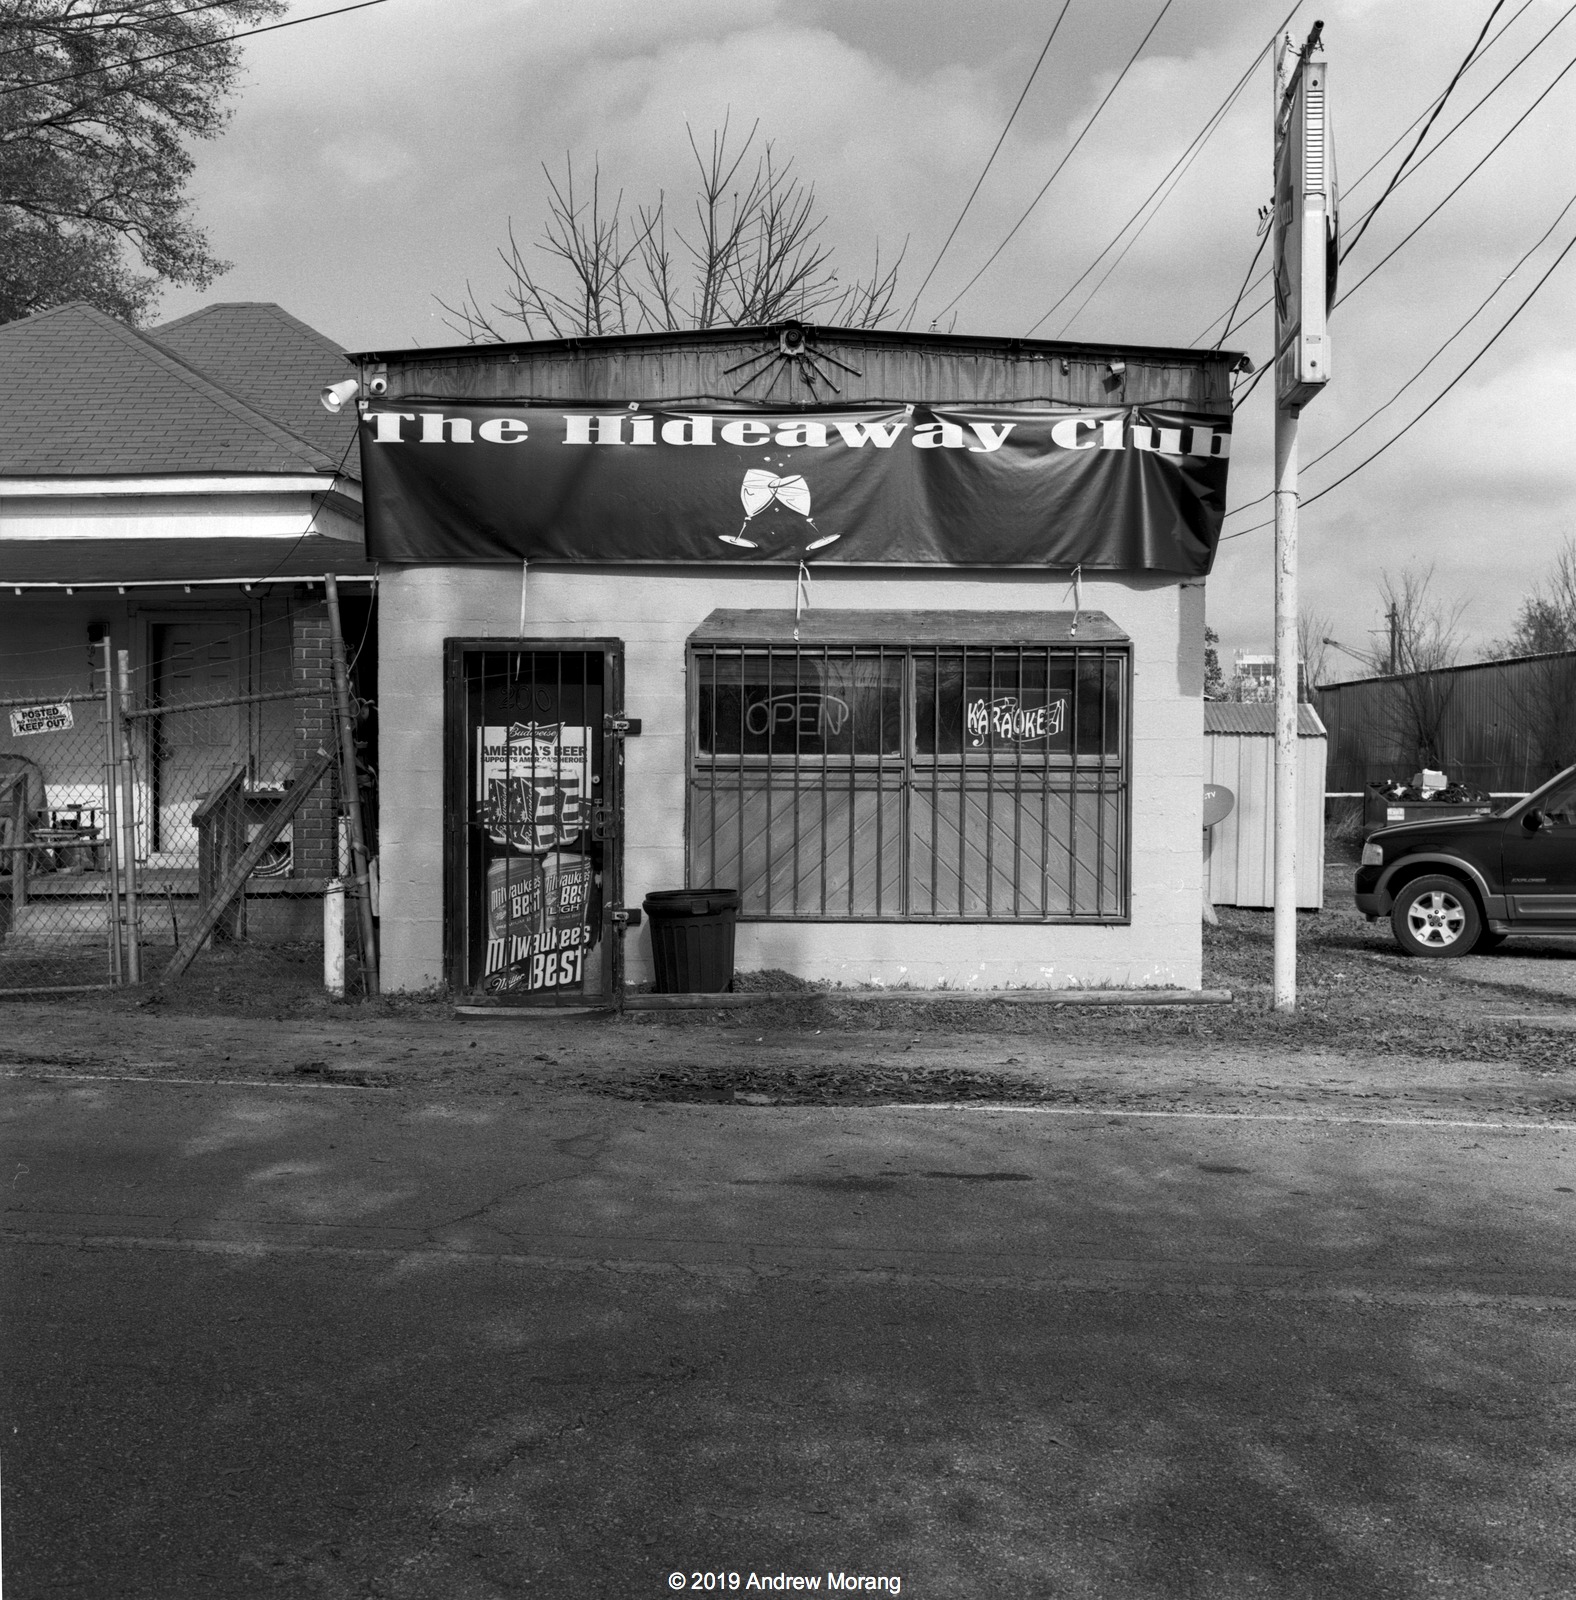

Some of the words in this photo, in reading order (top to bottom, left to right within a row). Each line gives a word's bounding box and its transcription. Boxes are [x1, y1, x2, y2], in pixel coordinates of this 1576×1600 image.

[362, 413, 528, 444] The
[562, 414, 1017, 453] Hideaway
[1051, 418, 1231, 458] Club
[21, 708, 59, 719] POSTED
[746, 702, 843, 735] OPEN
[967, 702, 1046, 738] KARAOKE
[19, 721, 43, 732] KEEP
[46, 718, 66, 728] OUT
[504, 726, 560, 738] Budweise
[481, 746, 551, 756] AMERICA'S
[554, 746, 588, 756] BEER
[549, 902, 585, 915] LGH
